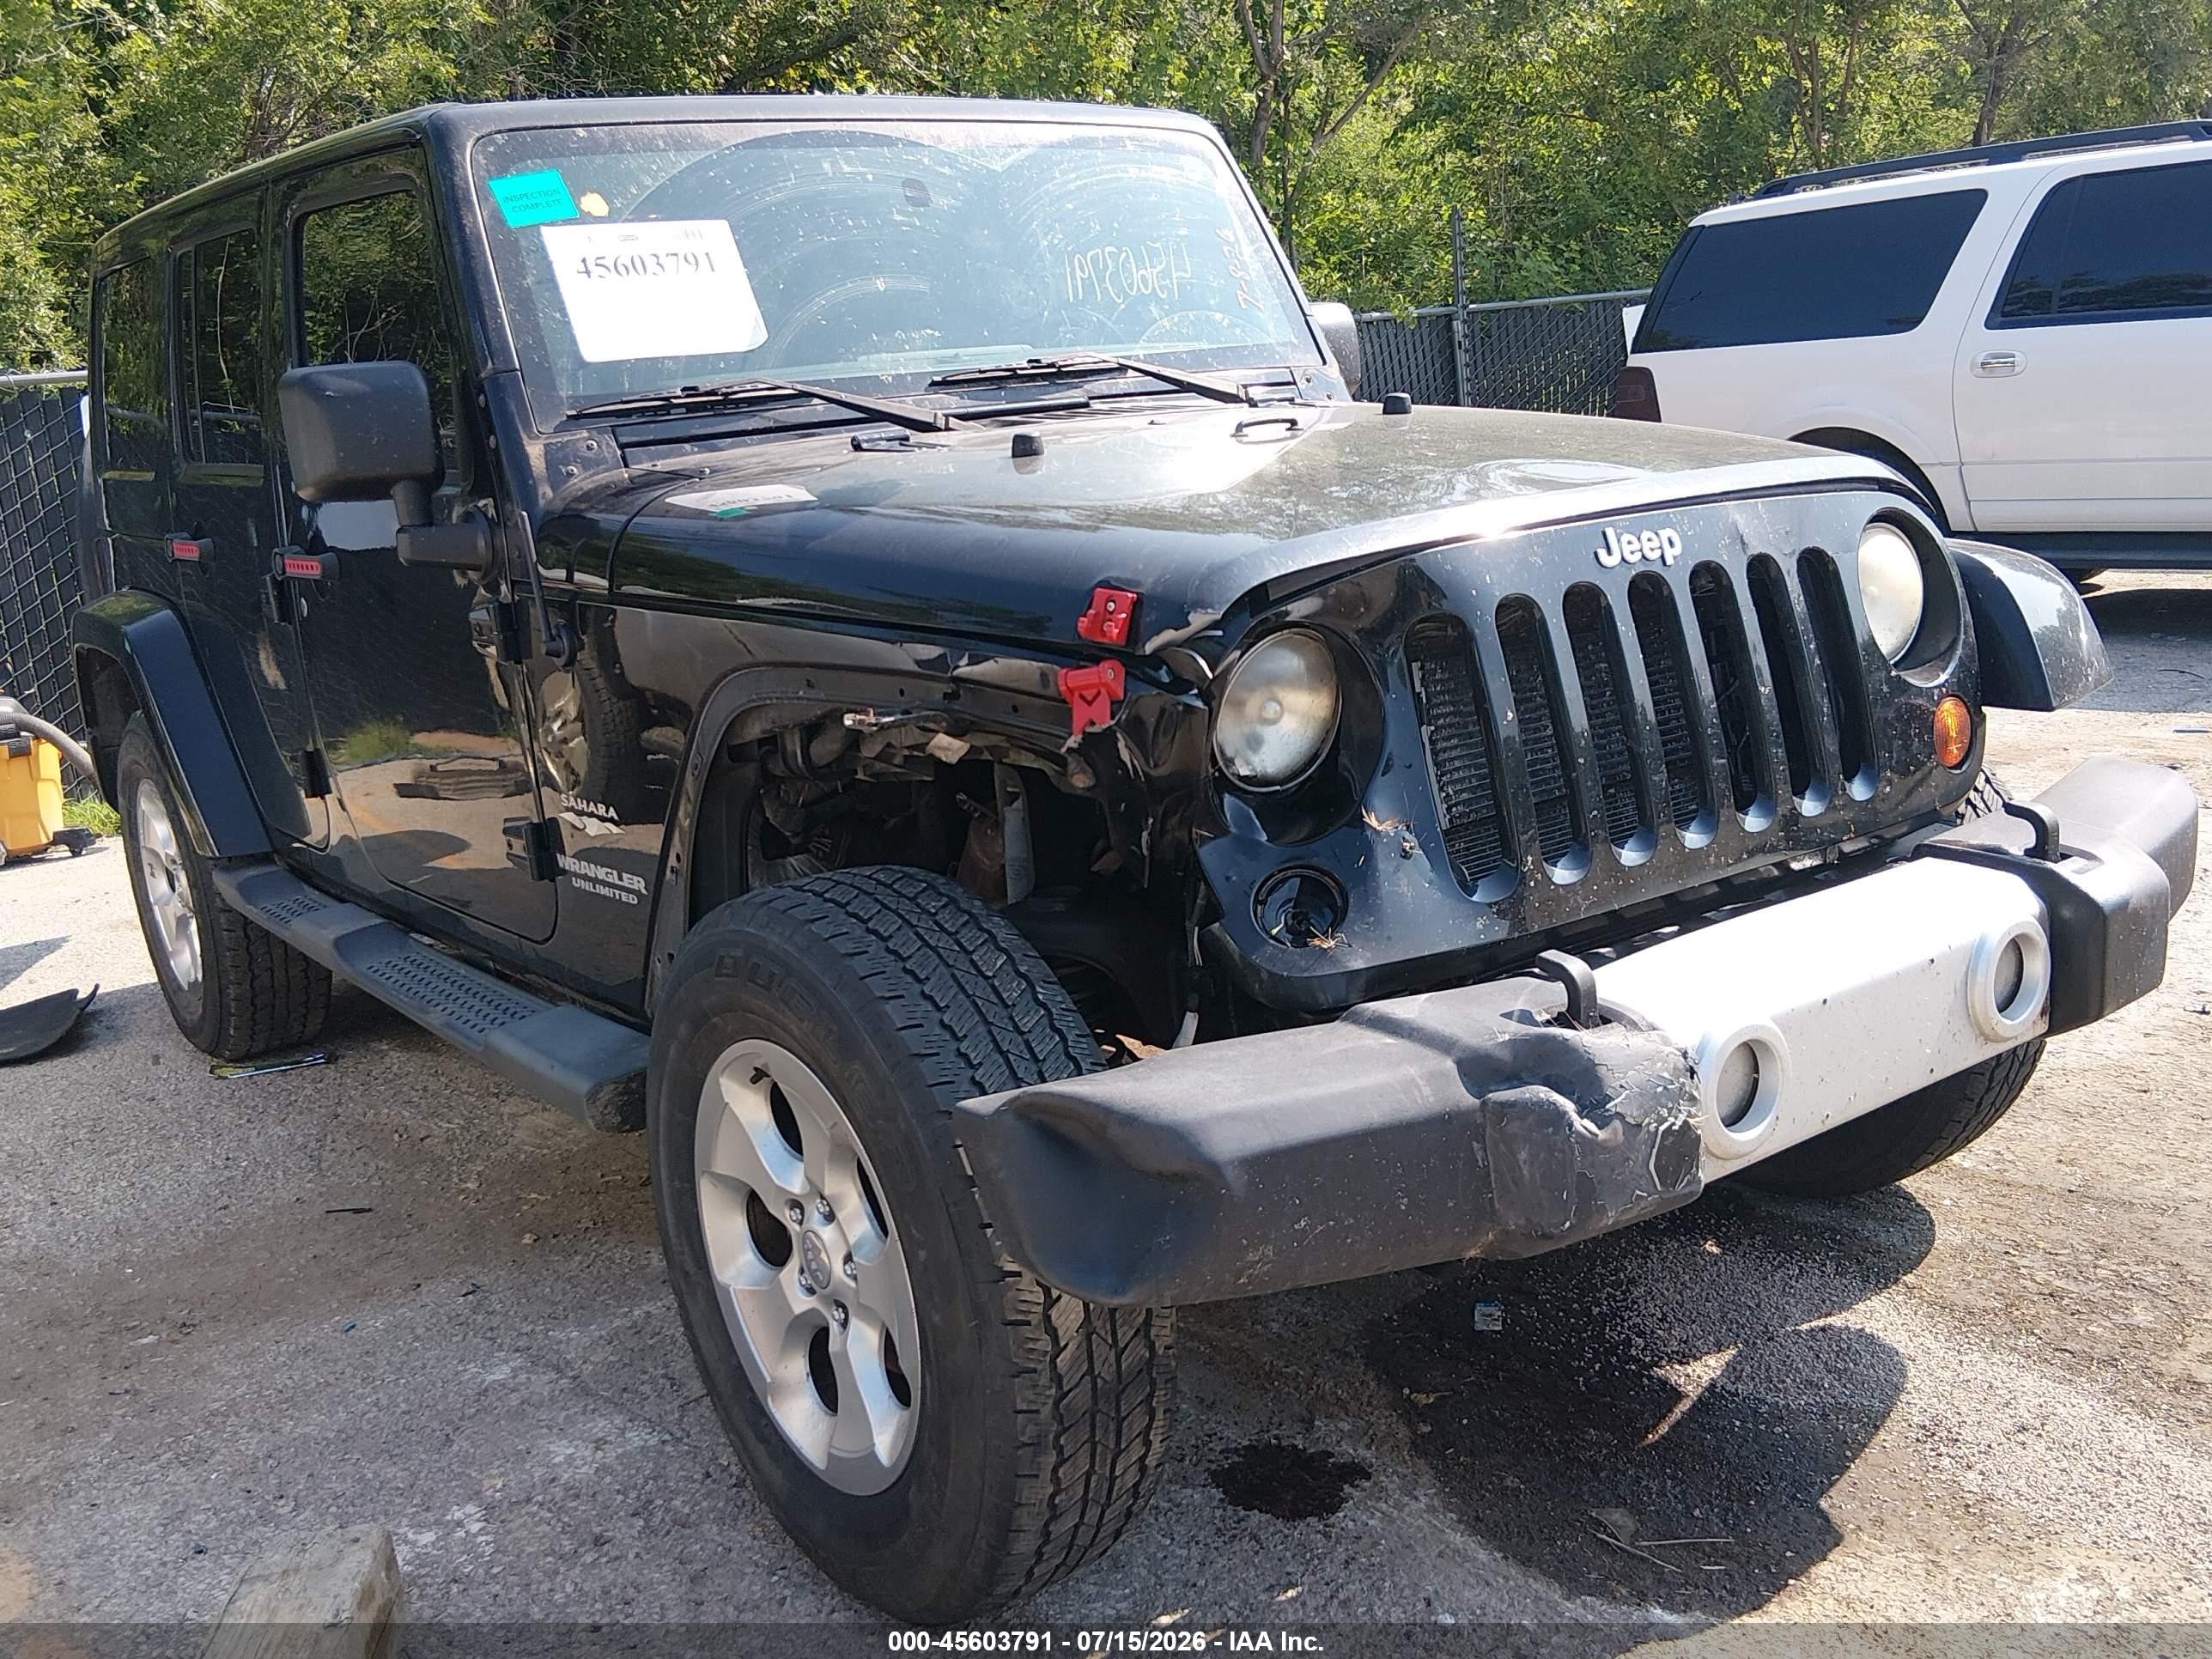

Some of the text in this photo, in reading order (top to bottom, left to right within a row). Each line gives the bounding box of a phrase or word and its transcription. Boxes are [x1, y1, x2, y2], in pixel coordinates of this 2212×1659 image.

[502, 187, 562, 204] INSPECTION
[512, 198, 563, 214] COMPLETE
[576, 252, 715, 279] 45603791
[1594, 526, 1682, 568] Jeep
[561, 793, 619, 821] SAHARA
[556, 853, 648, 895] WRANGLER
[572, 877, 639, 905] UNLIMITED
